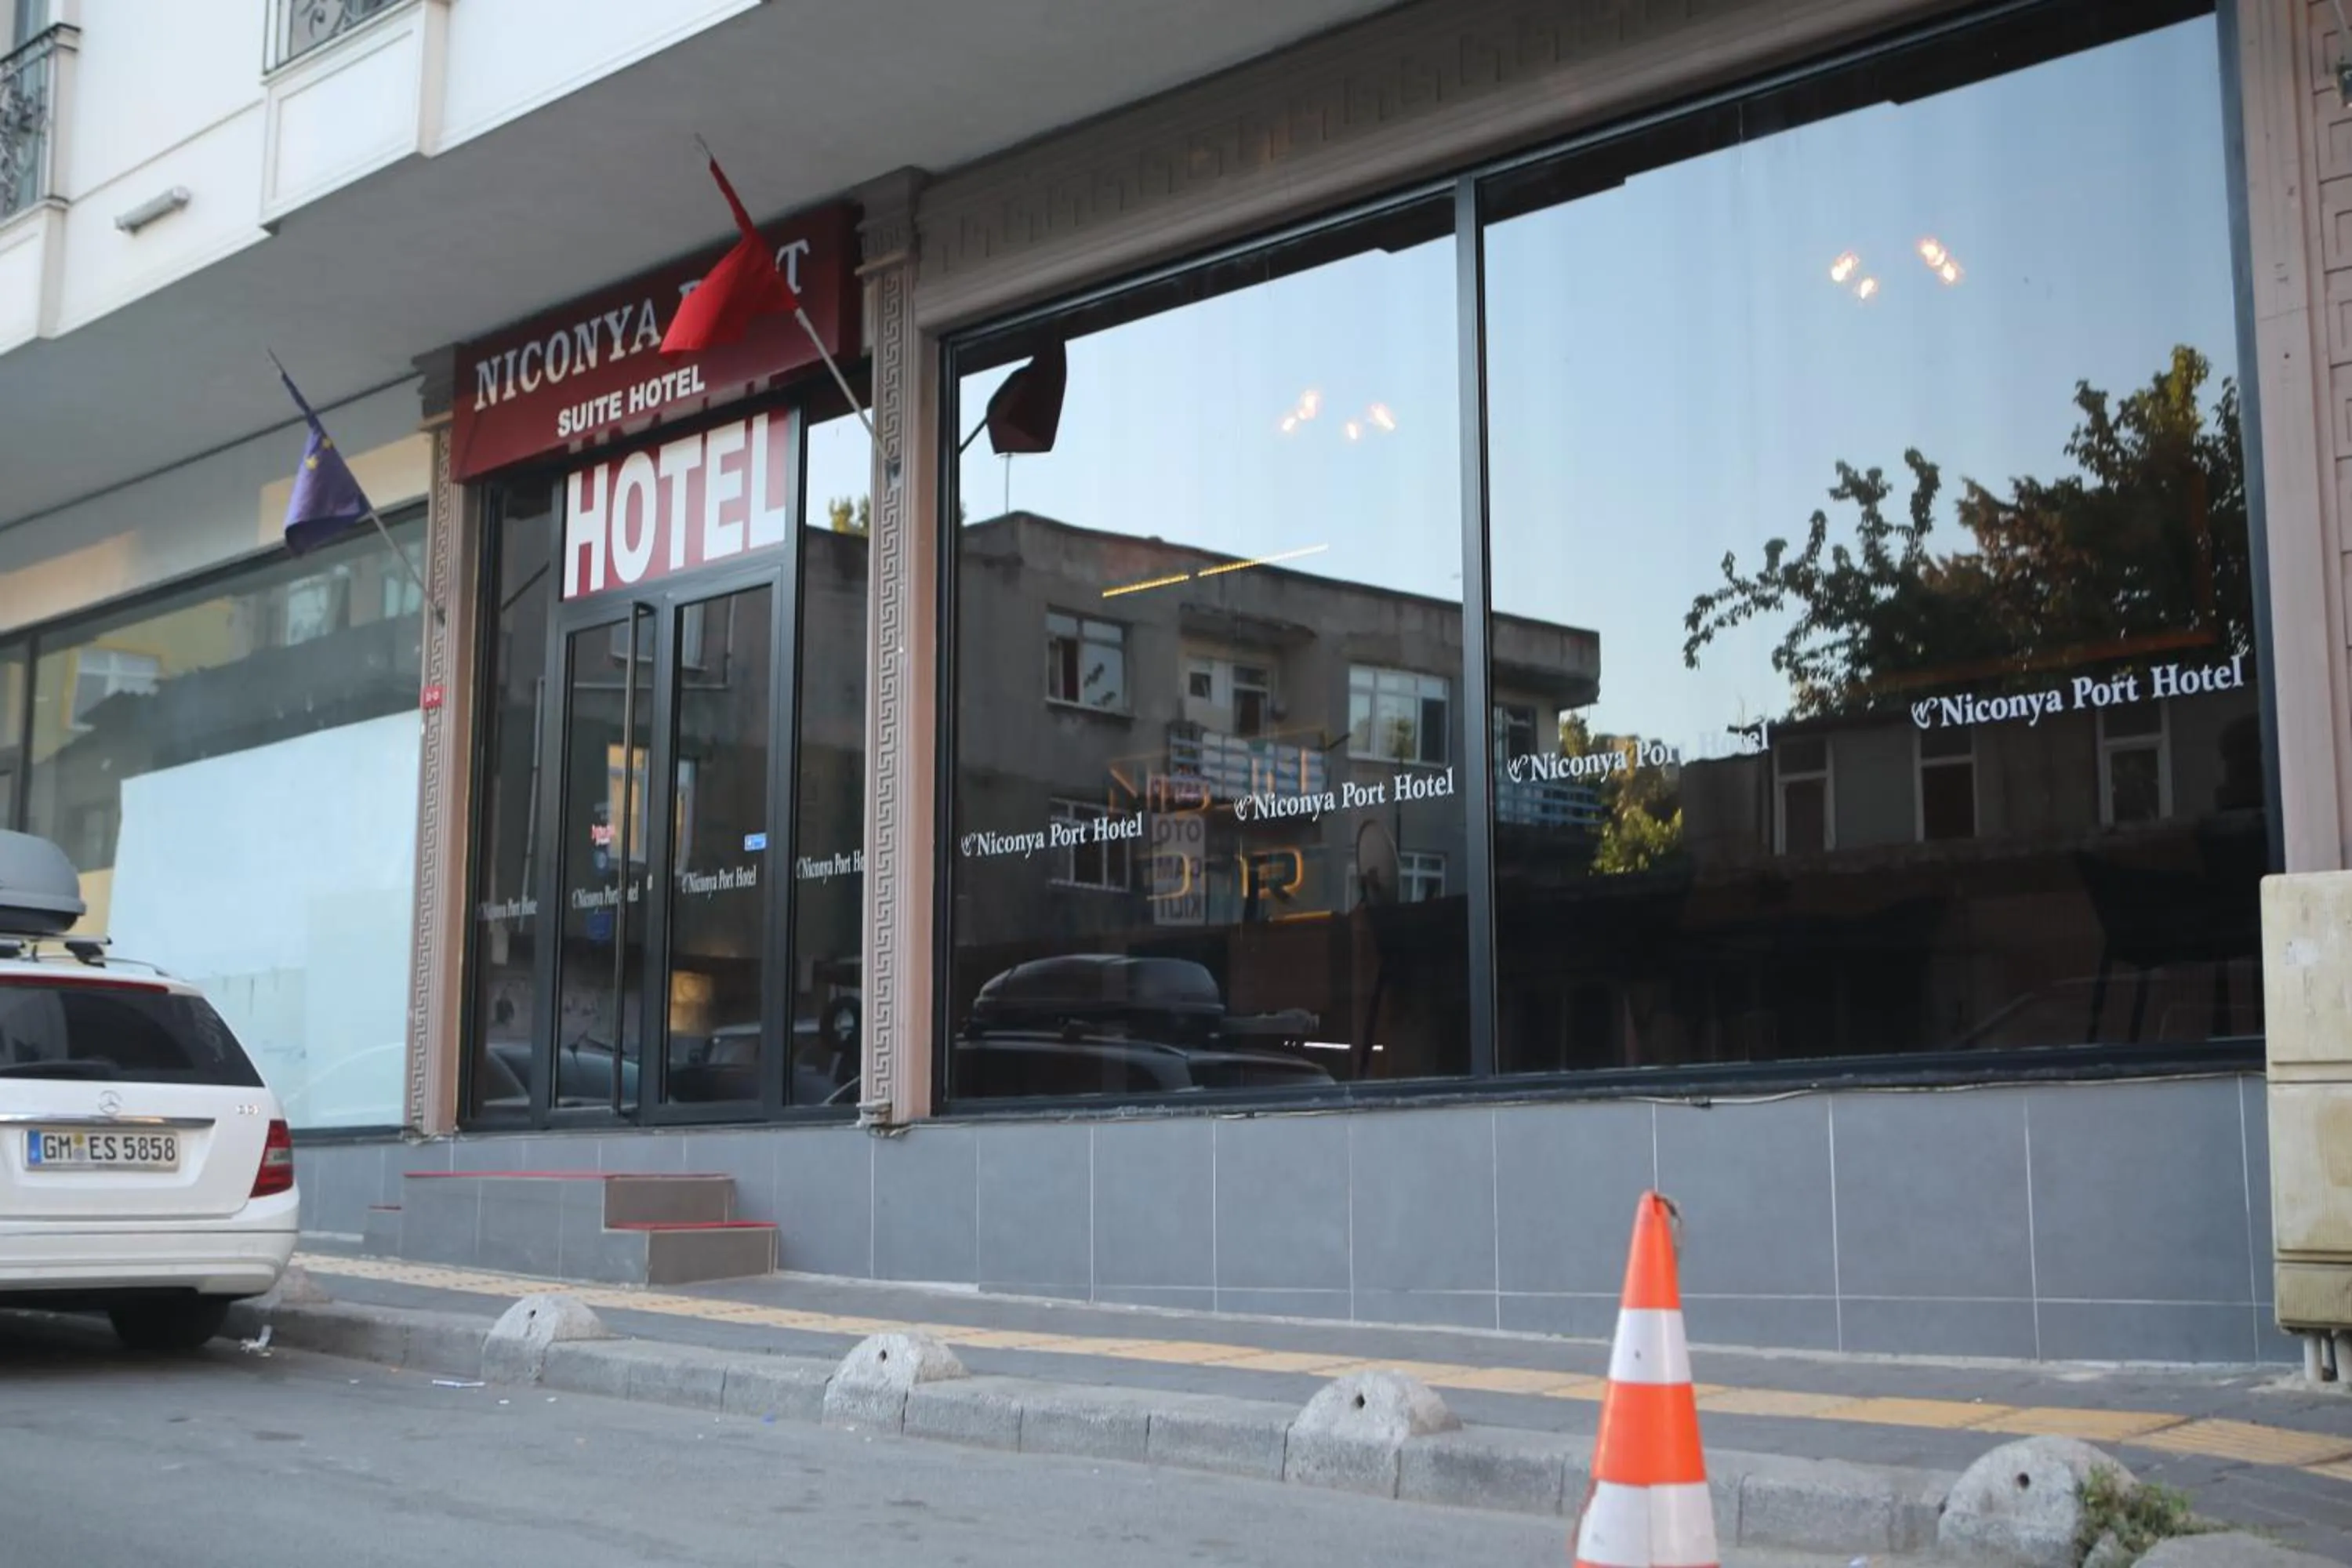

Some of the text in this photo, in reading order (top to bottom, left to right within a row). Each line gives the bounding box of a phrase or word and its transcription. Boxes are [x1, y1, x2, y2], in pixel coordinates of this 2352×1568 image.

[474, 298, 662, 412] NICONYA
[557, 365, 705, 437] SUITE HOTEL
[564, 412, 786, 598] HOTEL
[1940, 654, 2245, 727] Niconya Port Hotel
[1253, 766, 1454, 822] Niconya Port Hotel
[1530, 751, 1627, 783] Niconya
[976, 811, 1143, 859] Niconya Port Hotel
[735, 863, 757, 887] Hotel
[44, 1135, 176, 1161] GM ES 5858
